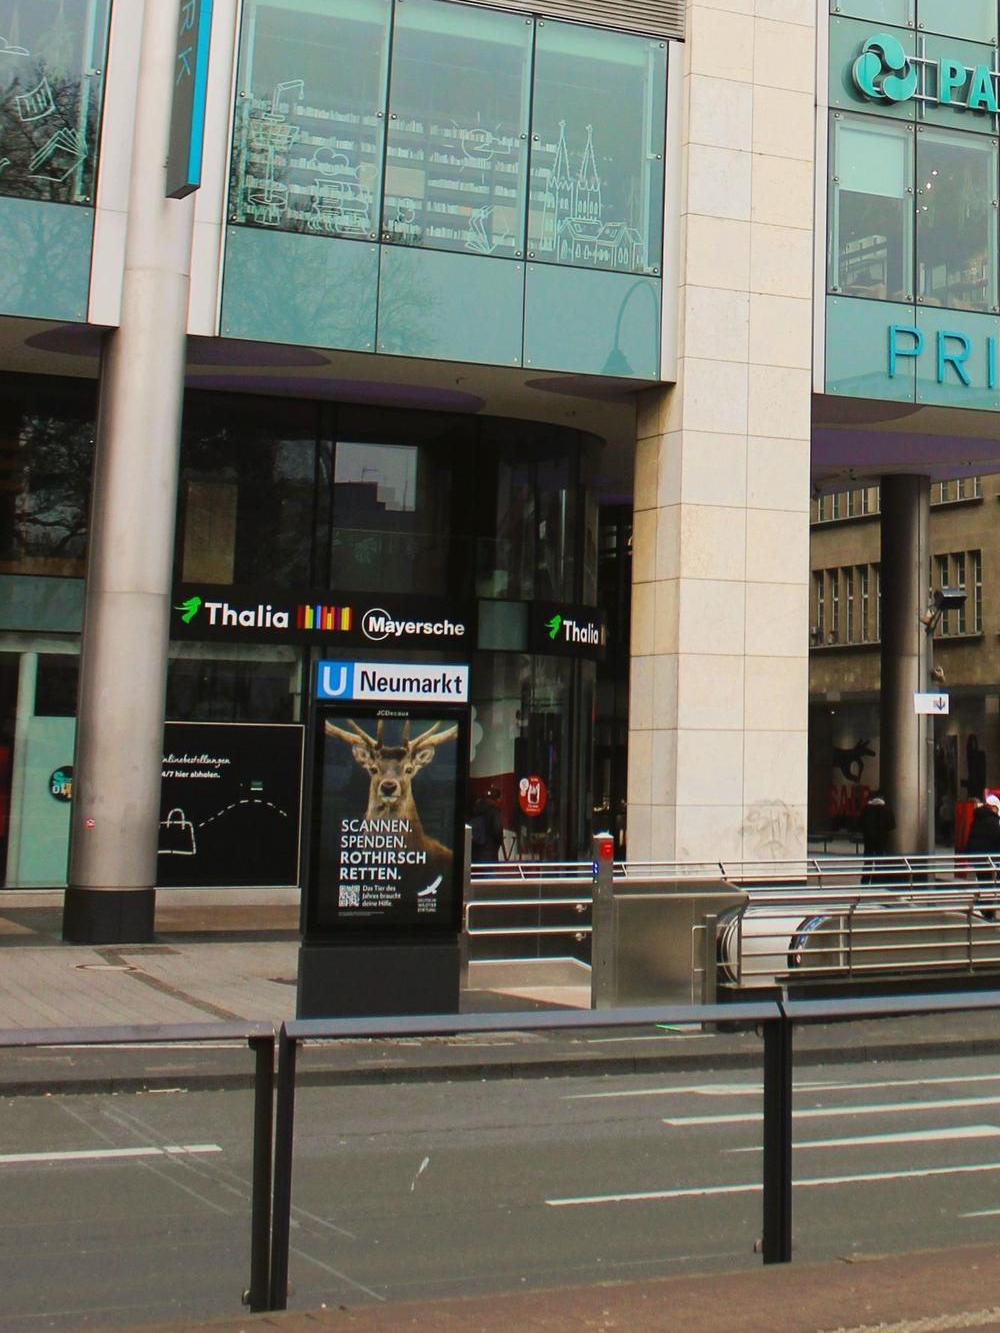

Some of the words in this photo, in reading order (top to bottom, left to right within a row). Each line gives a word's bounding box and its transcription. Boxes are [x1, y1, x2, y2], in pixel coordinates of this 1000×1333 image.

[205, 601, 289, 628] Thalia
[364, 611, 465, 638] Mayersche
[563, 619, 599, 644] Thalia
[323, 666, 347, 697] U
[360, 670, 462, 694] Neumarkt
[162, 753, 230, 768] nlinebestellungen
[341, 819, 413, 833] SCANNEN.
[340, 835, 407, 849] SPENDEN.
[340, 851, 427, 864] ROTHIRSCH
[339, 867, 402, 880] RETTEN.
[362, 884, 373, 892] Das
[374, 884, 385, 892] Tier
[386, 884, 396, 892] des
[362, 892, 379, 900] Jahres
[380, 892, 401, 900] braucht
